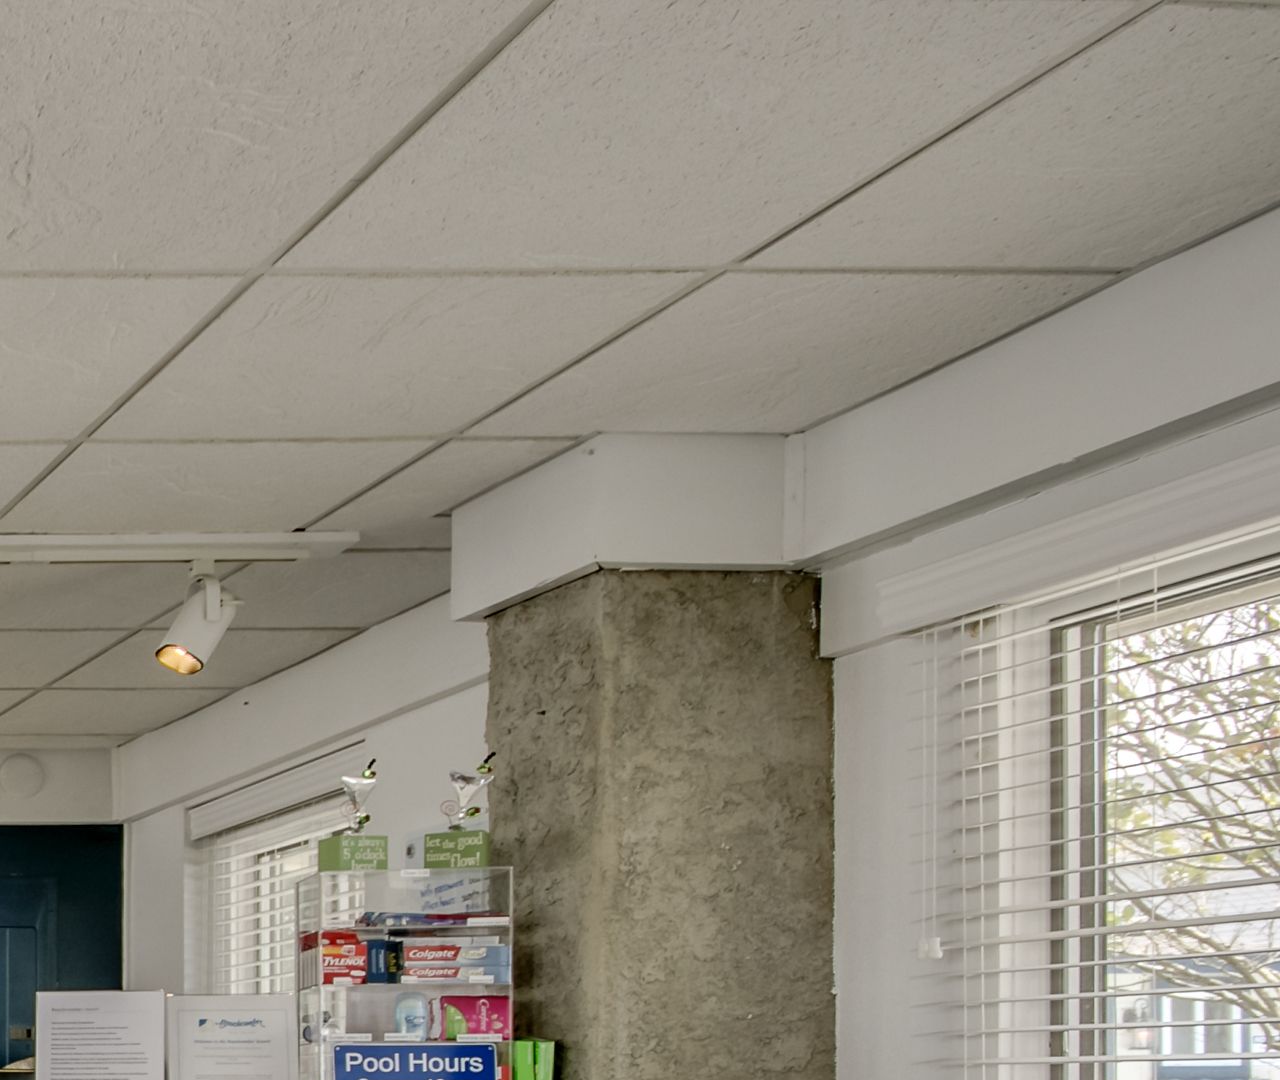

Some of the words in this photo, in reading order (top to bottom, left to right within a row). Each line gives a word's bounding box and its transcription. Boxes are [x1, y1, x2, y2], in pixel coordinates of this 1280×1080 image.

[457, 832, 483, 850] good
[450, 852, 481, 868] flow!
[323, 956, 367, 966] TYLENOL
[408, 949, 456, 960] Colgate
[409, 967, 456, 977] Colgate
[344, 1053, 400, 1073] Pool
[409, 1053, 484, 1073] Hours
